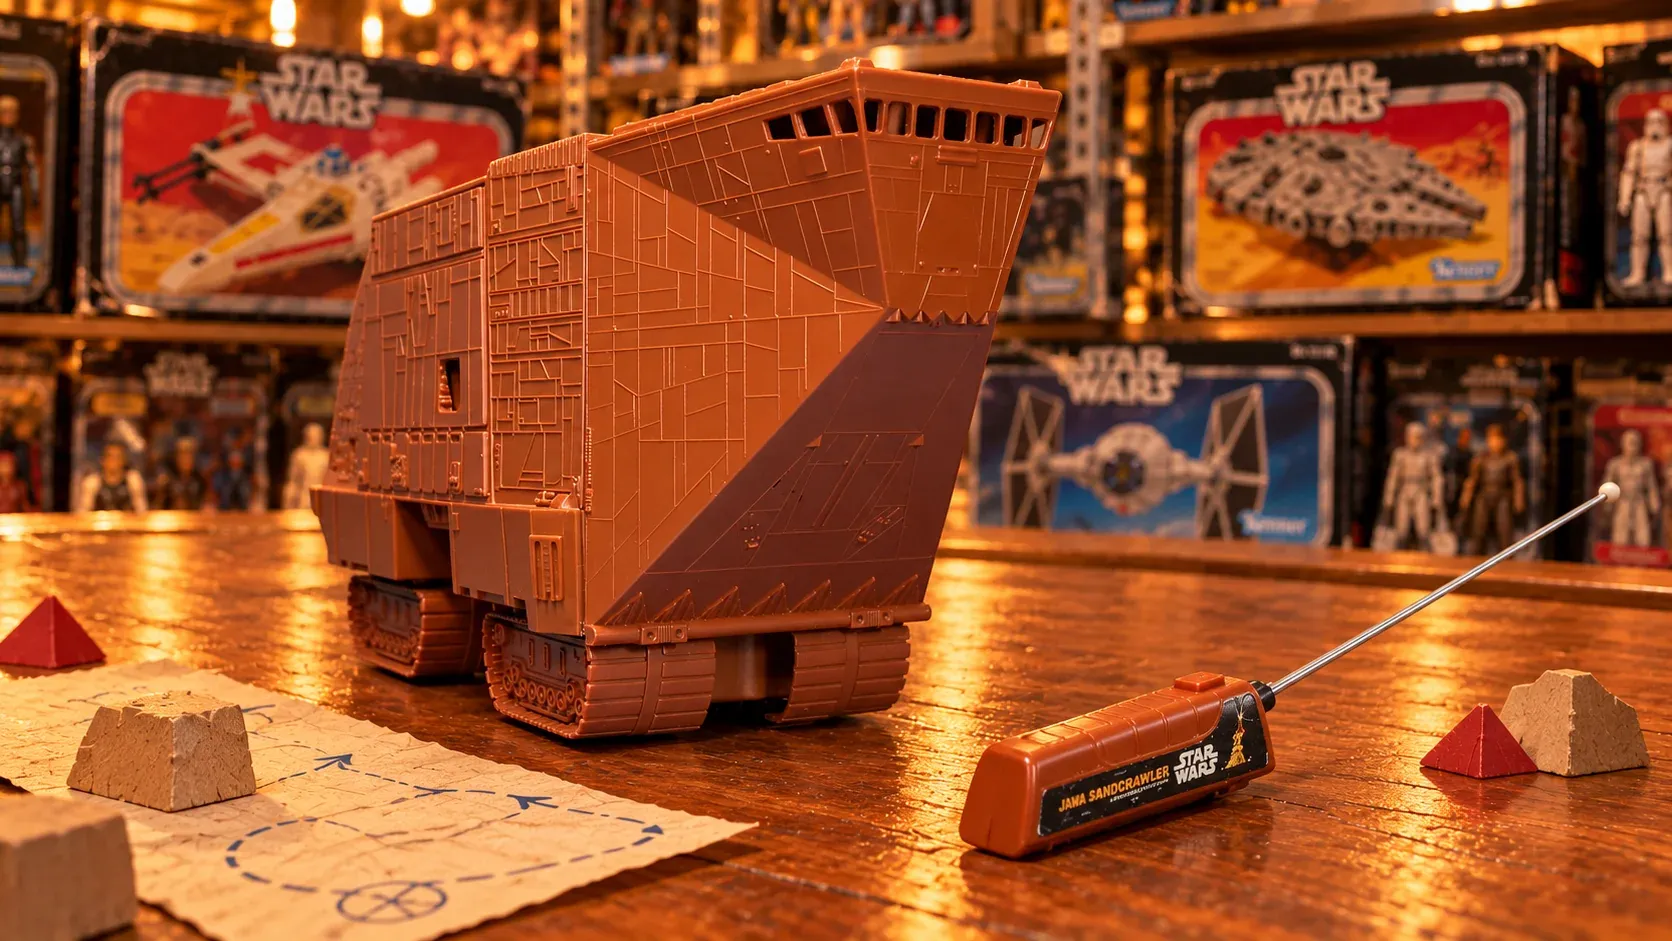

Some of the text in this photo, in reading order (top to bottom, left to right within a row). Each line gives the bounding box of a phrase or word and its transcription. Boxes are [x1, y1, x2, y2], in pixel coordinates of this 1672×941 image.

[260, 54, 381, 93] STAR
[1274, 61, 1391, 95] STAR
[260, 84, 381, 130] WARS
[1277, 88, 1391, 128] WARS
[1070, 345, 1182, 375] STAR
[1064, 373, 1182, 406] WARS
[1173, 743, 1219, 771] STAR
[1174, 757, 1219, 785] WARS
[1058, 792, 1087, 813] JAWA
[1088, 765, 1171, 803] SANDCRAWLER
